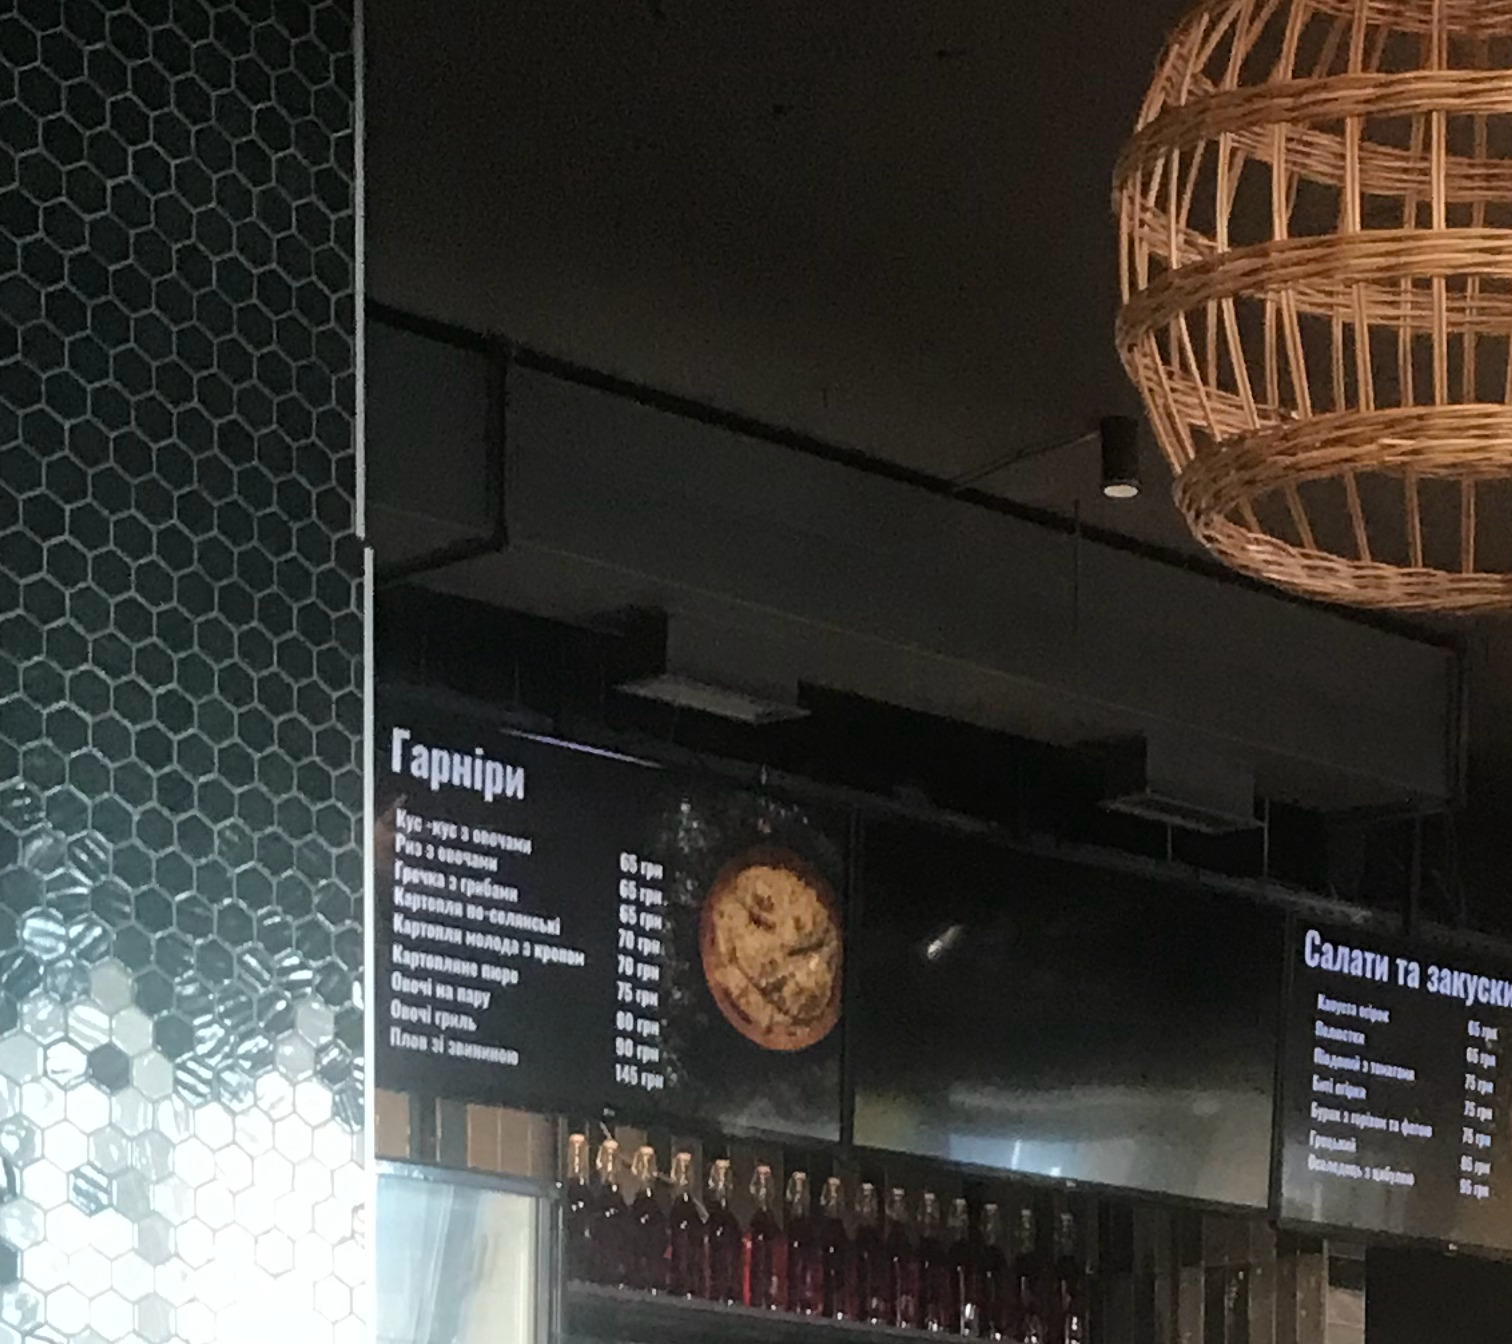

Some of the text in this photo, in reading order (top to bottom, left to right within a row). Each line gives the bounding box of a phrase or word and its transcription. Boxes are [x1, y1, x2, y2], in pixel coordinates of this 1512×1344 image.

[391, 726, 525, 802] Гарніри
[396, 807, 423, 833] Кус
[472, 828, 533, 855] овочами
[394, 857, 446, 889] Гречка
[460, 876, 519, 903] грибами
[619, 851, 664, 881] 65 грн
[393, 885, 464, 918] Картопля
[393, 911, 463, 945] Картопля
[465, 930, 520, 957] молода
[618, 927, 635, 950] 70
[1304, 928, 1390, 983] Салати
[1395, 957, 1421, 990] та
[391, 970, 491, 1010] Овочі на пару
[616, 980, 633, 1003] 75
[390, 997, 432, 1025] Овочі
[389, 1025, 428, 1051] Плов
